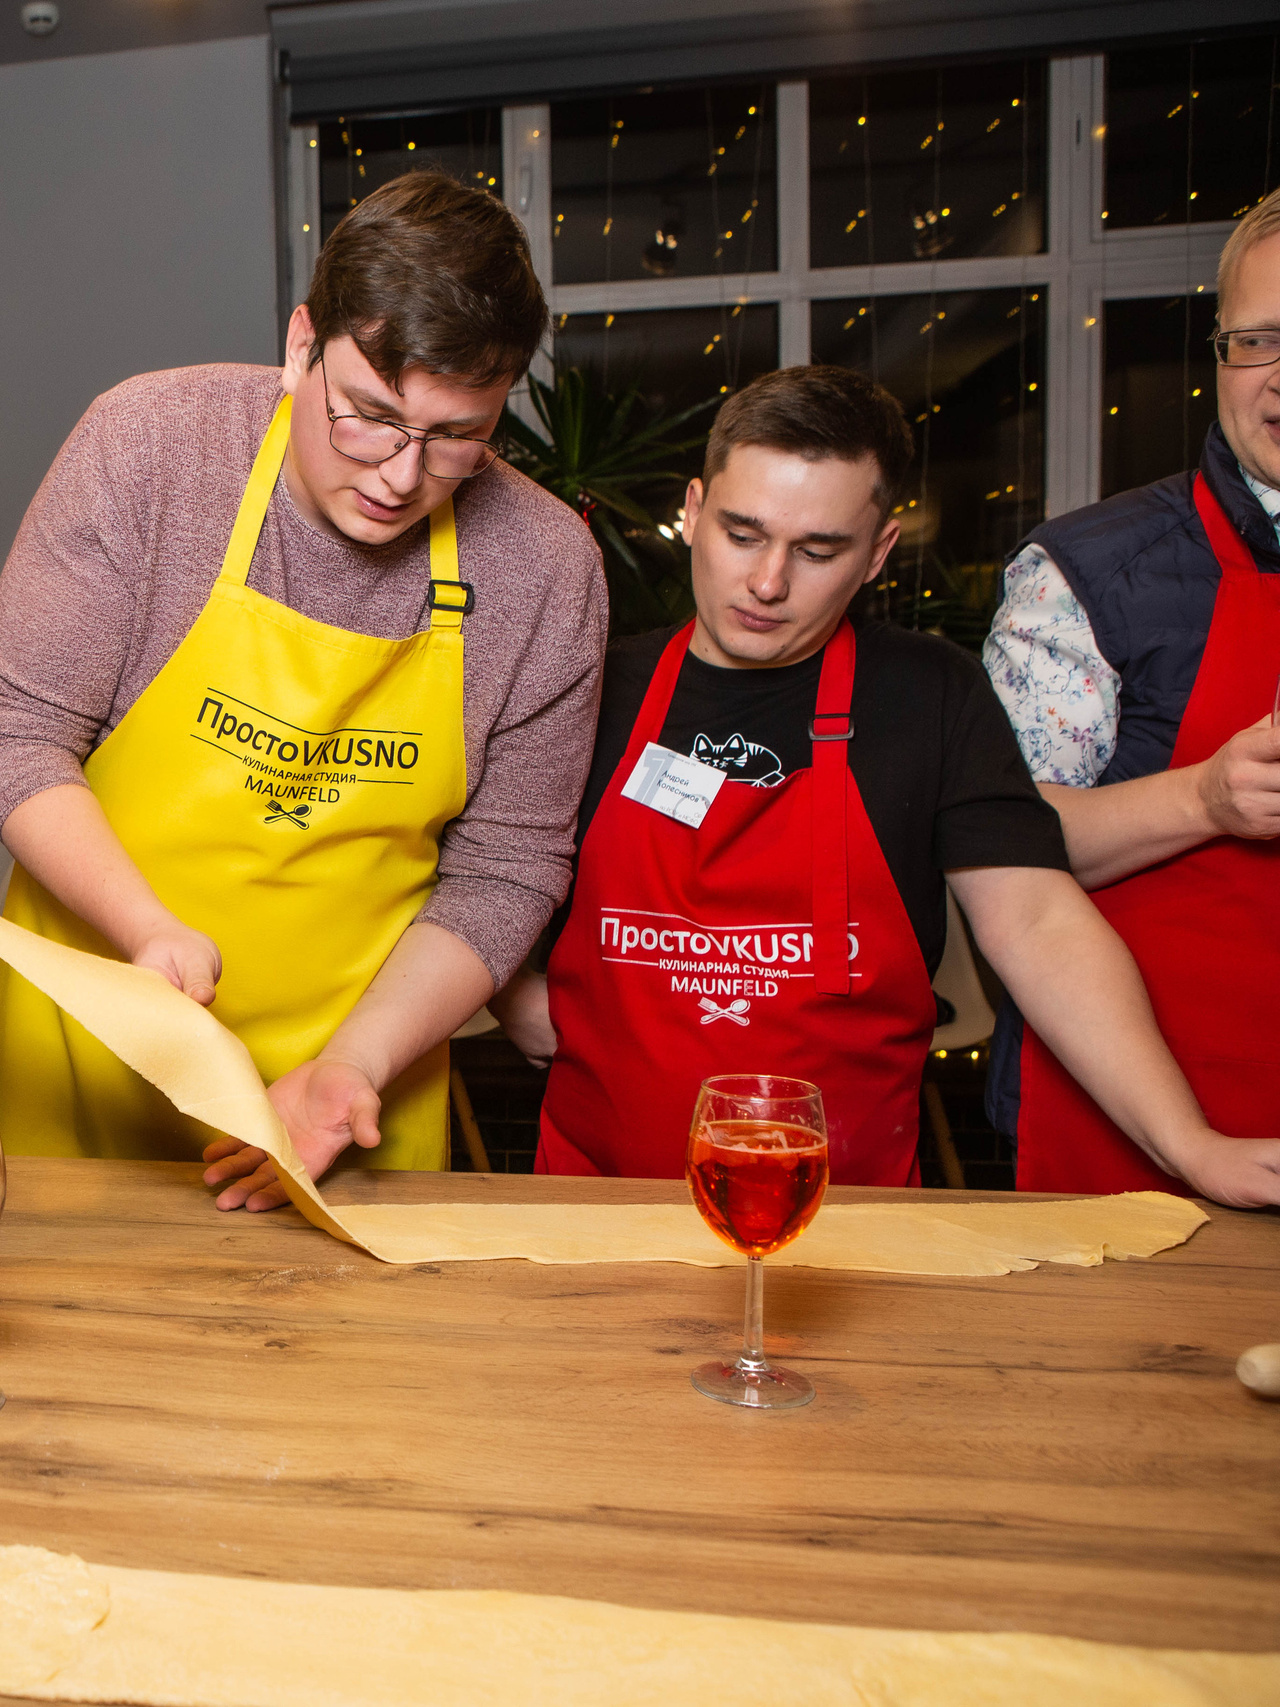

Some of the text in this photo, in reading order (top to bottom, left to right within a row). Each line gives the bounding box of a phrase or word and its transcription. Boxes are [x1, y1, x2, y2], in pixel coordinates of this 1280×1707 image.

[196, 697, 418, 769] ПростоVKUSNO
[242, 755, 356, 784] КУЛИНАРНАЯ СТУДИЯ
[661, 770, 689, 787] Андрей
[244, 775, 340, 803] MAUNFELD
[659, 958, 790, 980] КУЛИНАРНАЯ СТУДИЯ
[671, 976, 779, 997] MAUNFELD
